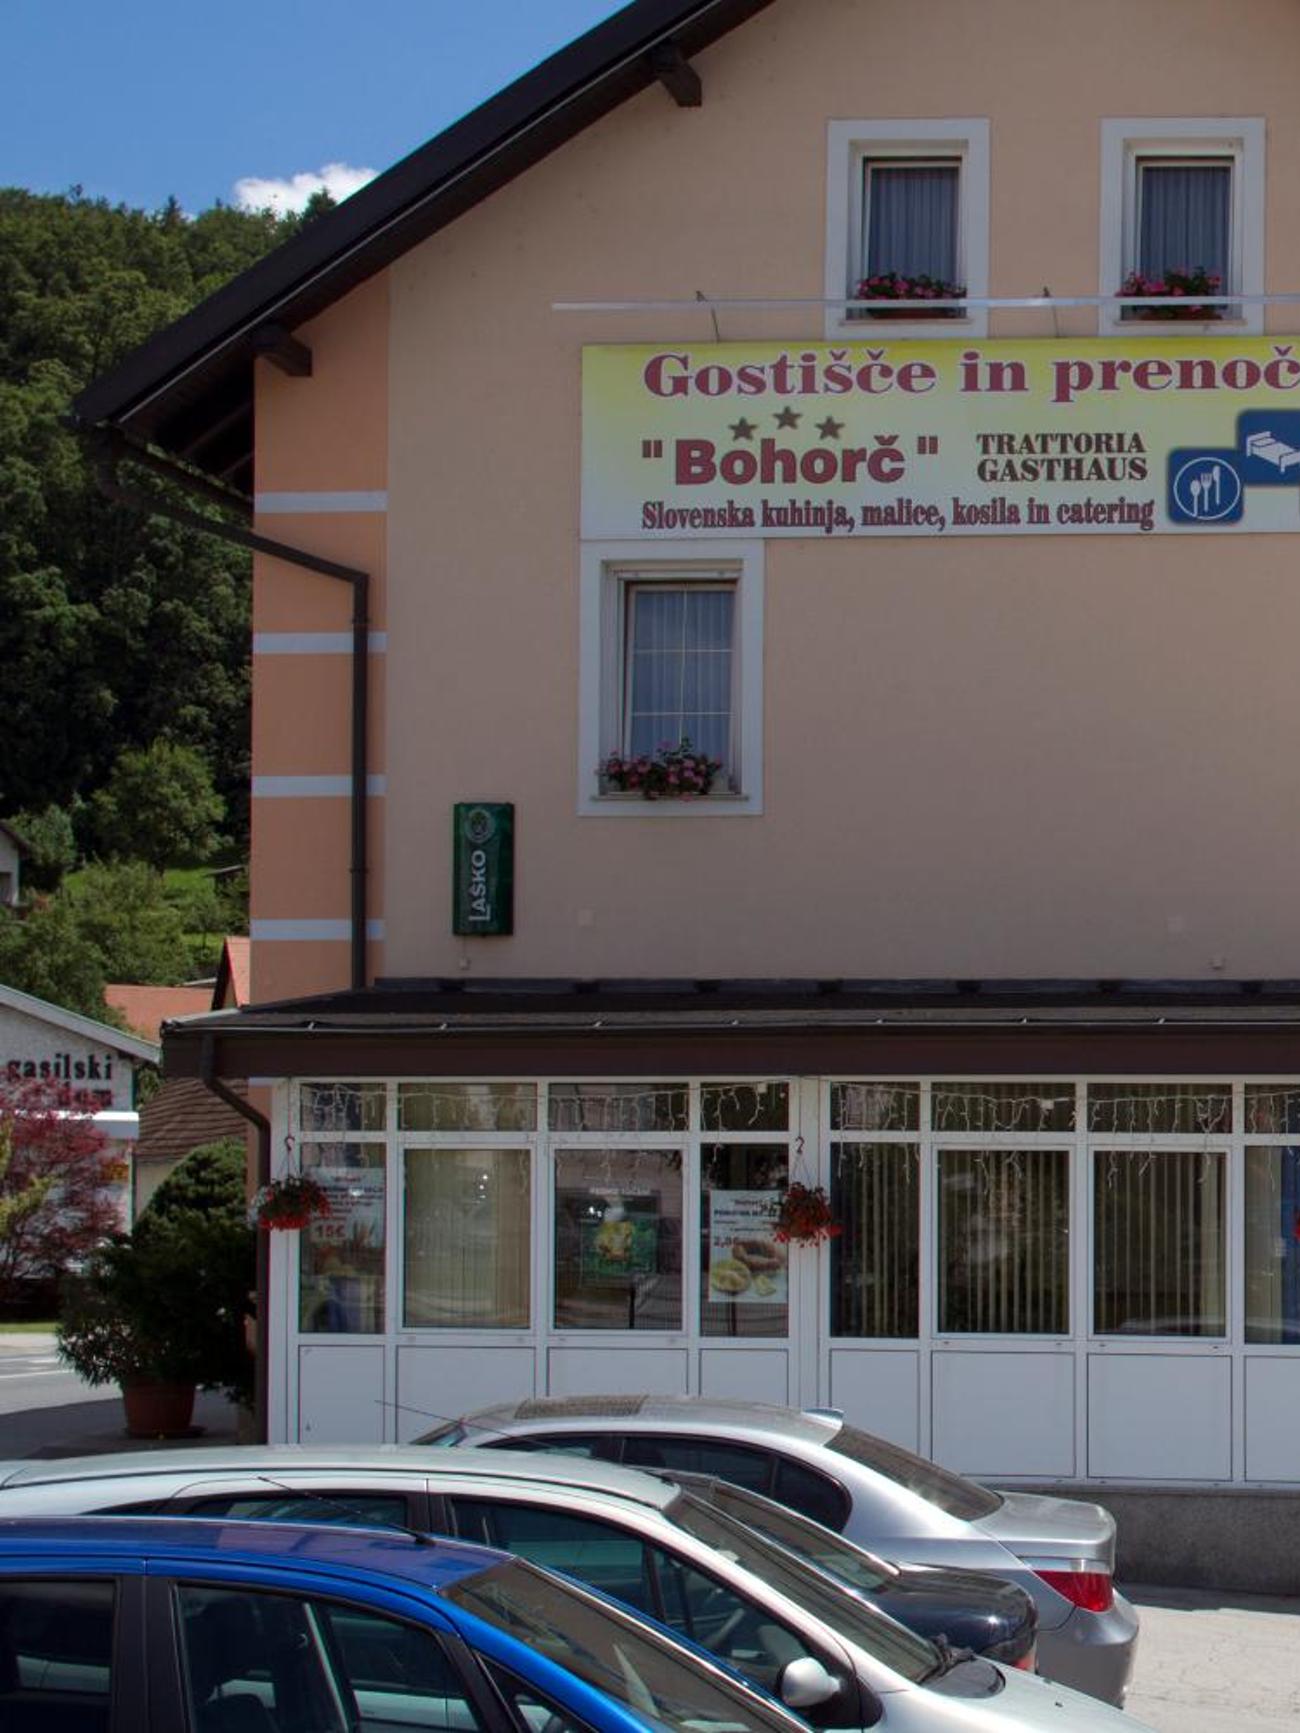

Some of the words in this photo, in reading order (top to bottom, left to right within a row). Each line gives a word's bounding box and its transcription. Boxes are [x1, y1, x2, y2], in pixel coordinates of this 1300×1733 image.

[643, 349, 936, 396] Gostišče
[960, 351, 1029, 393] in
[977, 431, 1146, 456] TRATTORIA
[977, 456, 1149, 483] GASTHAUS
[641, 500, 755, 529] Slovenska
[761, 499, 854, 533] kuhinja,
[861, 497, 946, 531] malice,
[952, 497, 1019, 527] kosila
[1026, 497, 1050, 525] in
[1057, 496, 1154, 531] catering
